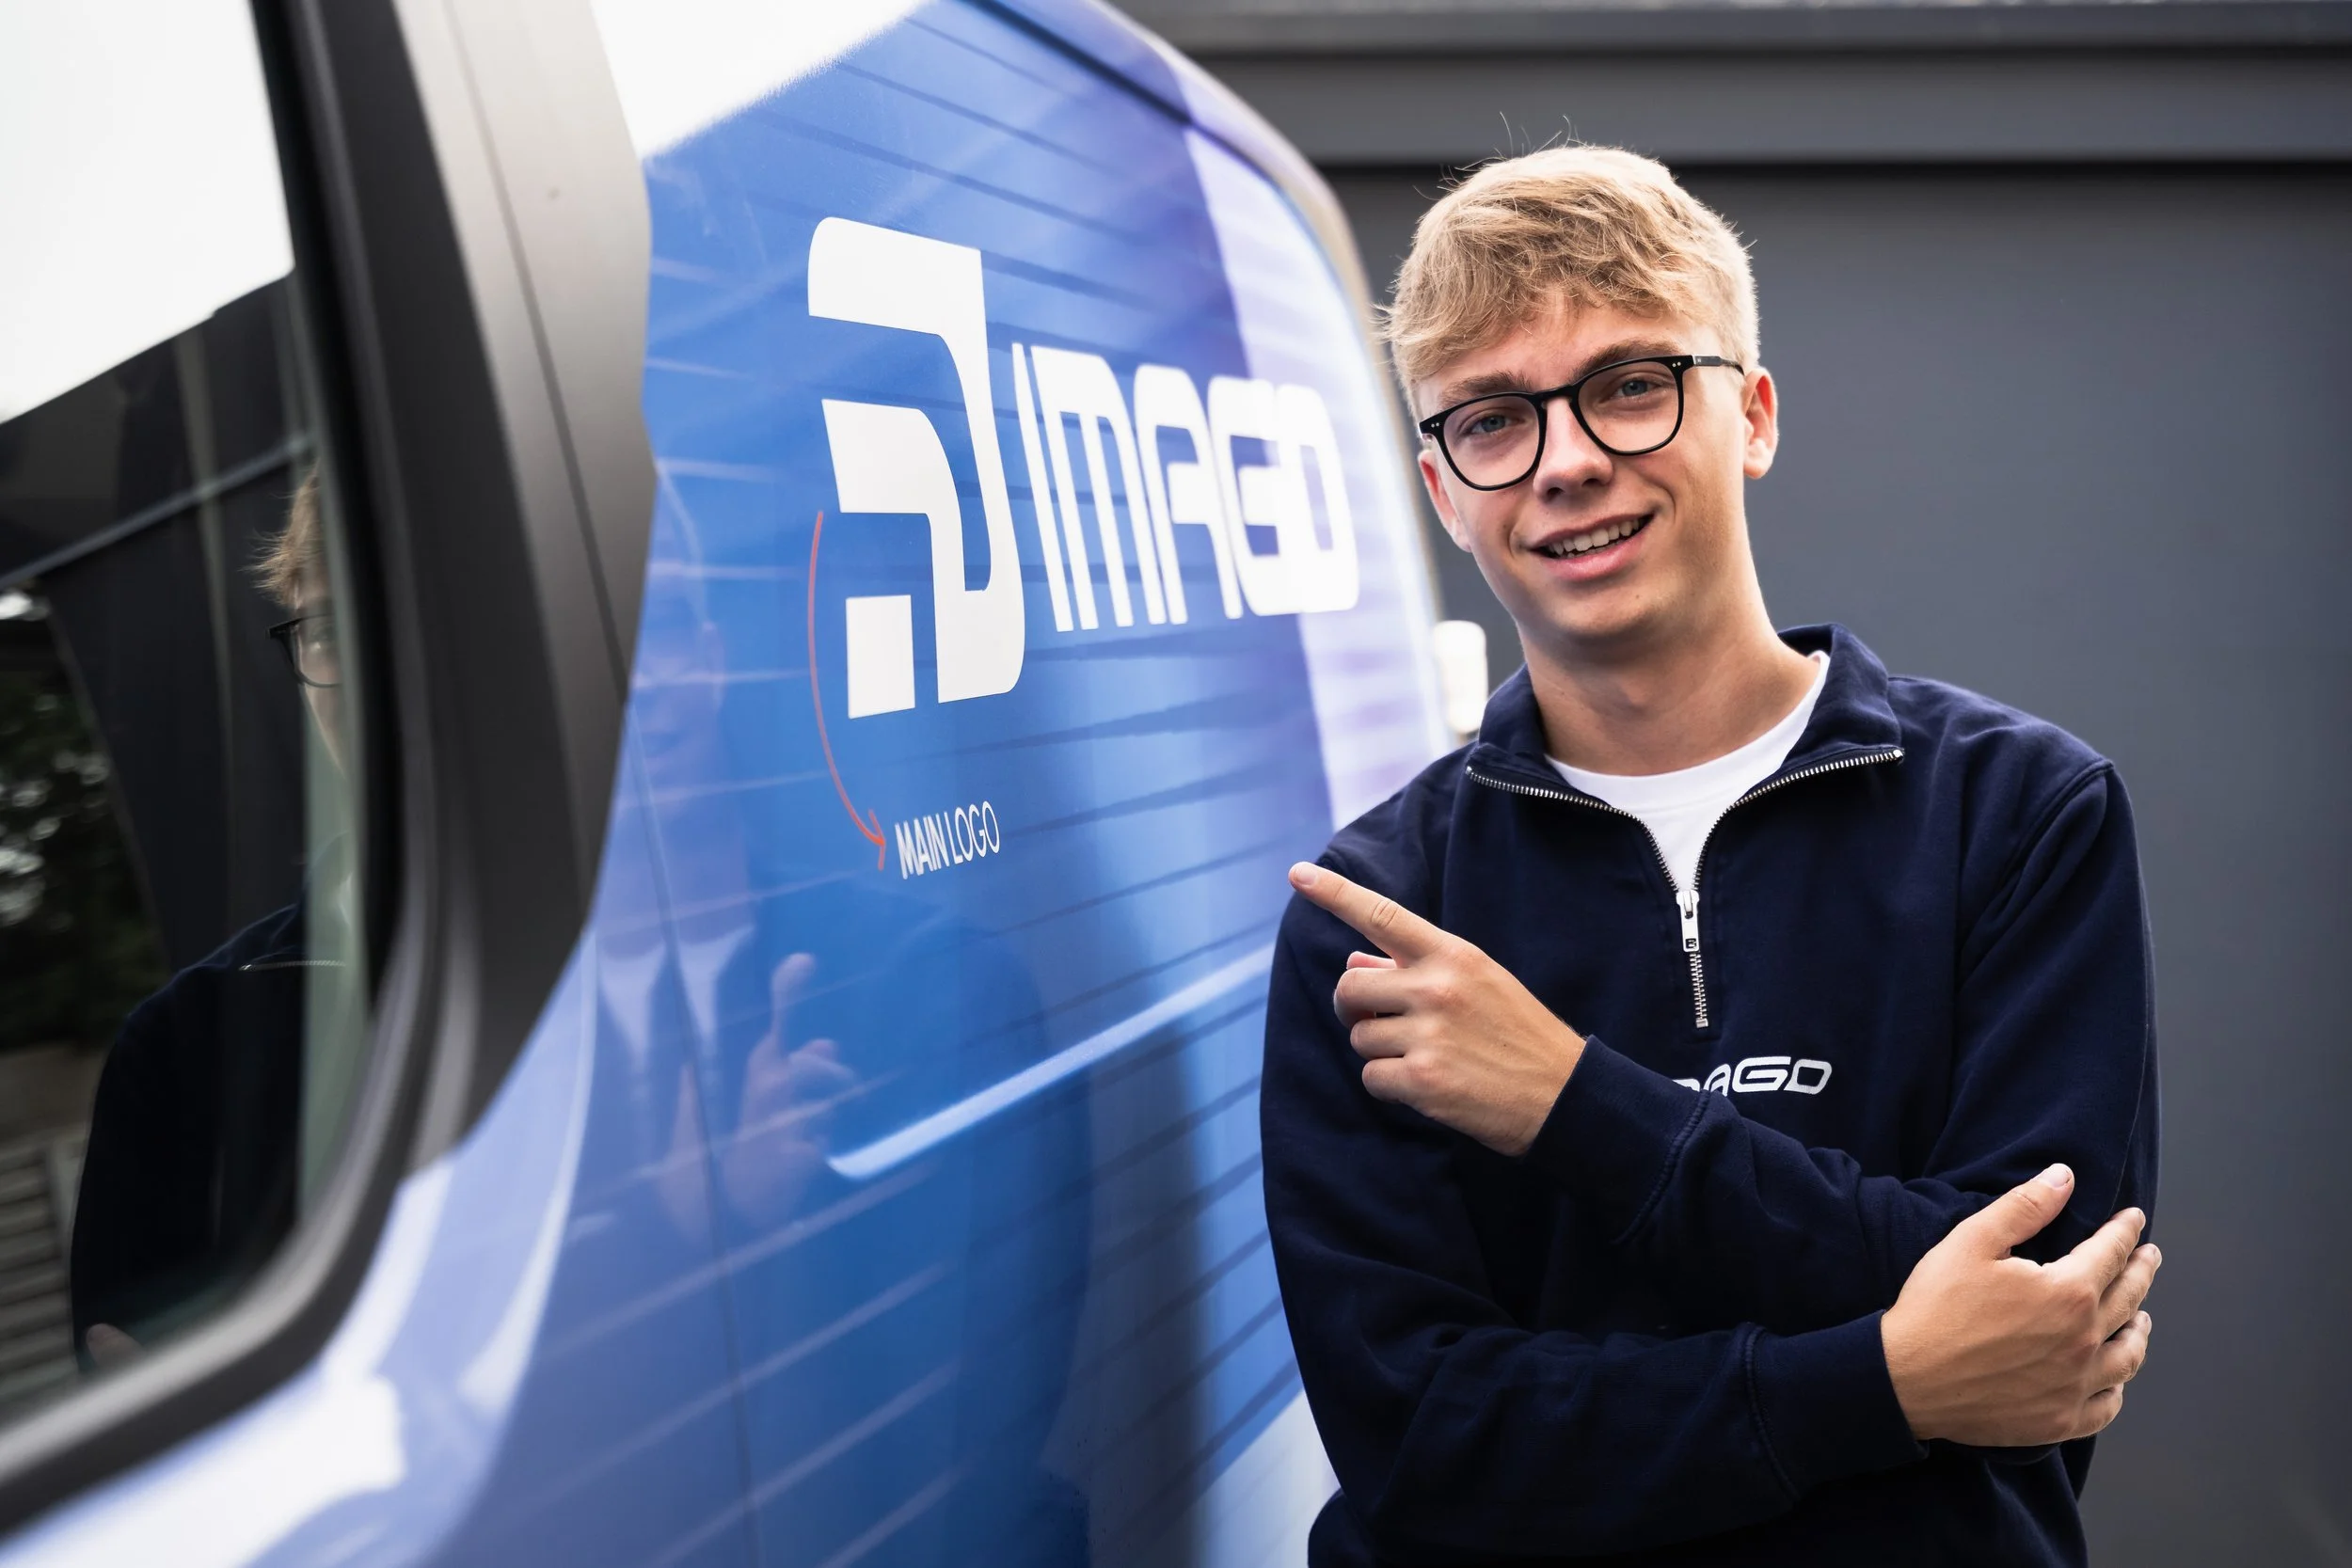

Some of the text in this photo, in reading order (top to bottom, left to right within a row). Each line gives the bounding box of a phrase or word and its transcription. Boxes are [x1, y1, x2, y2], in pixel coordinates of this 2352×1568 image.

[1012, 342, 1359, 632] IMAGO
[895, 800, 1000, 880] MAIN LOGO
